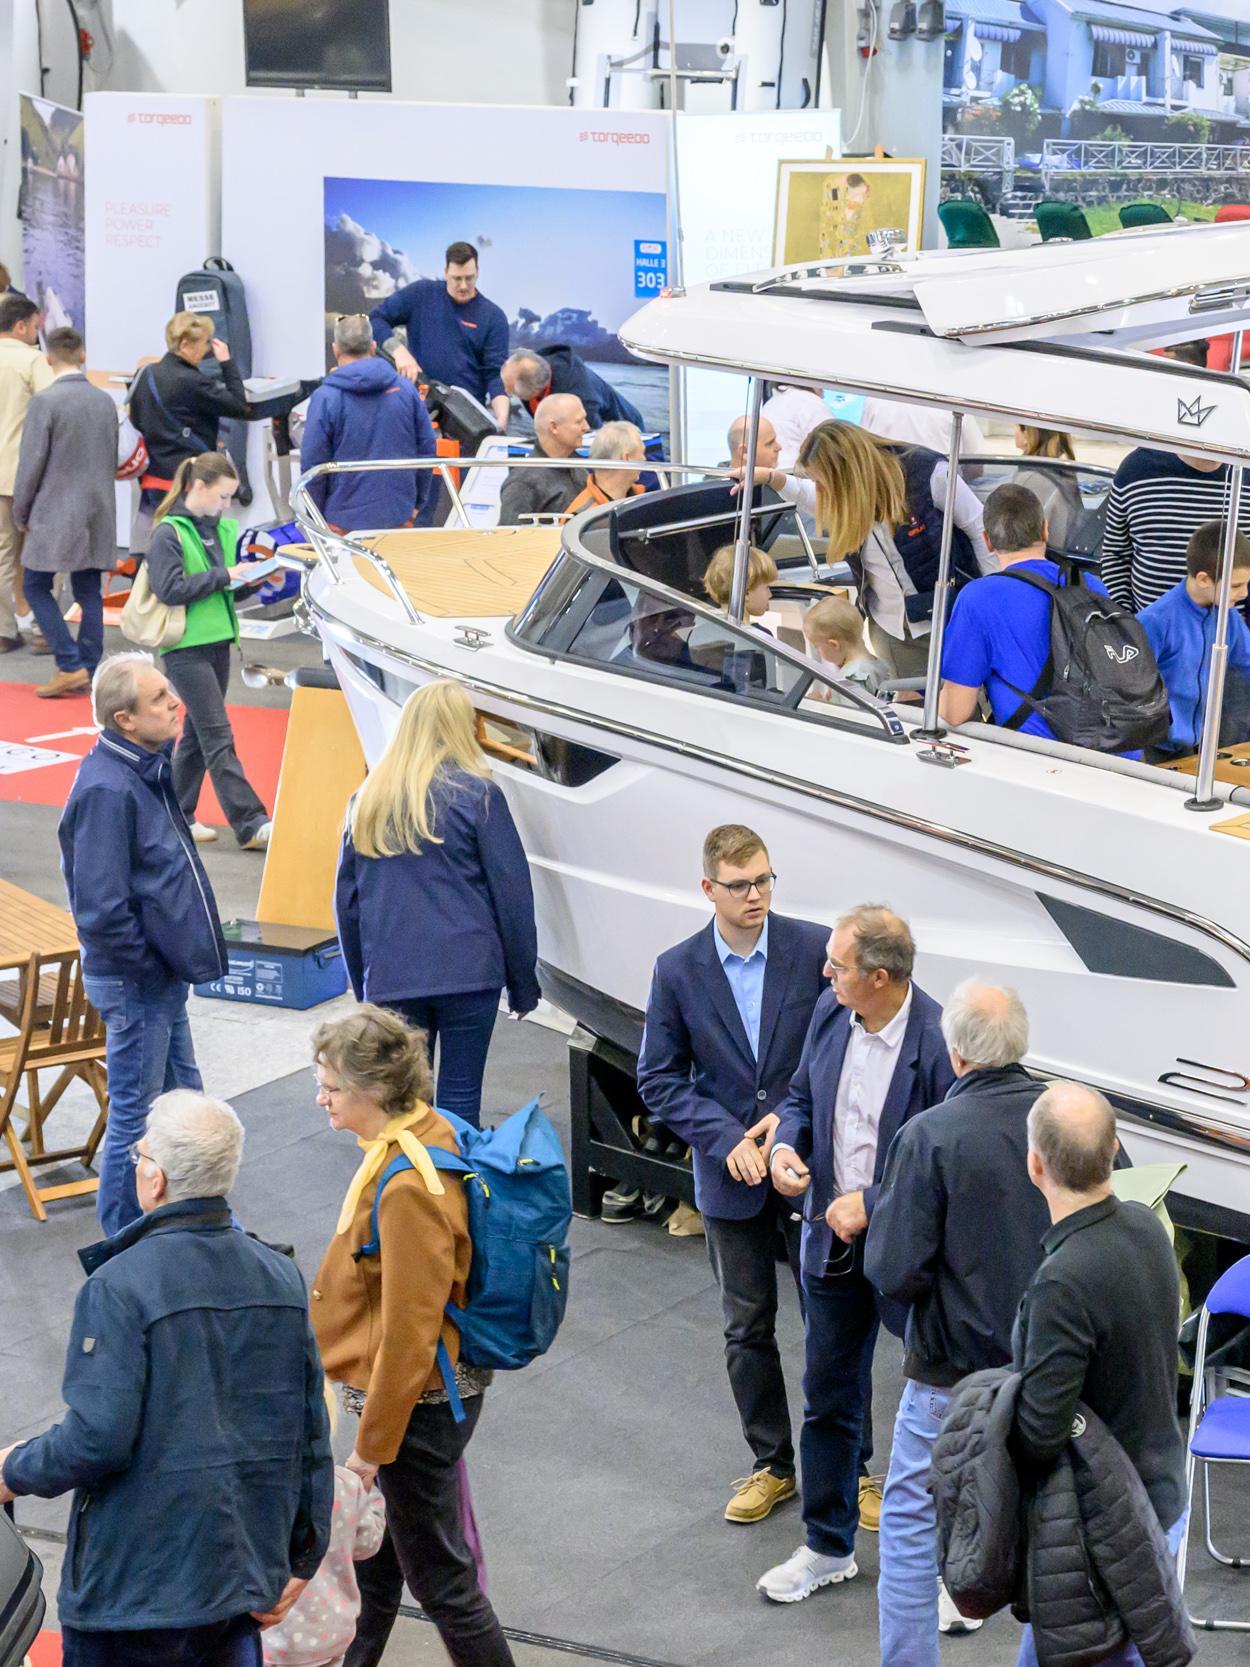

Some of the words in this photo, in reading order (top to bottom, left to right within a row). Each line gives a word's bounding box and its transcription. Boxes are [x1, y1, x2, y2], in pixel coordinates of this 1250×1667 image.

[105, 200, 170, 217] PLEASURE
[105, 217, 153, 232] POWER
[105, 233, 160, 248] RESPECT
[636, 258, 659, 268] HALLE
[637, 272, 665, 288] 303
